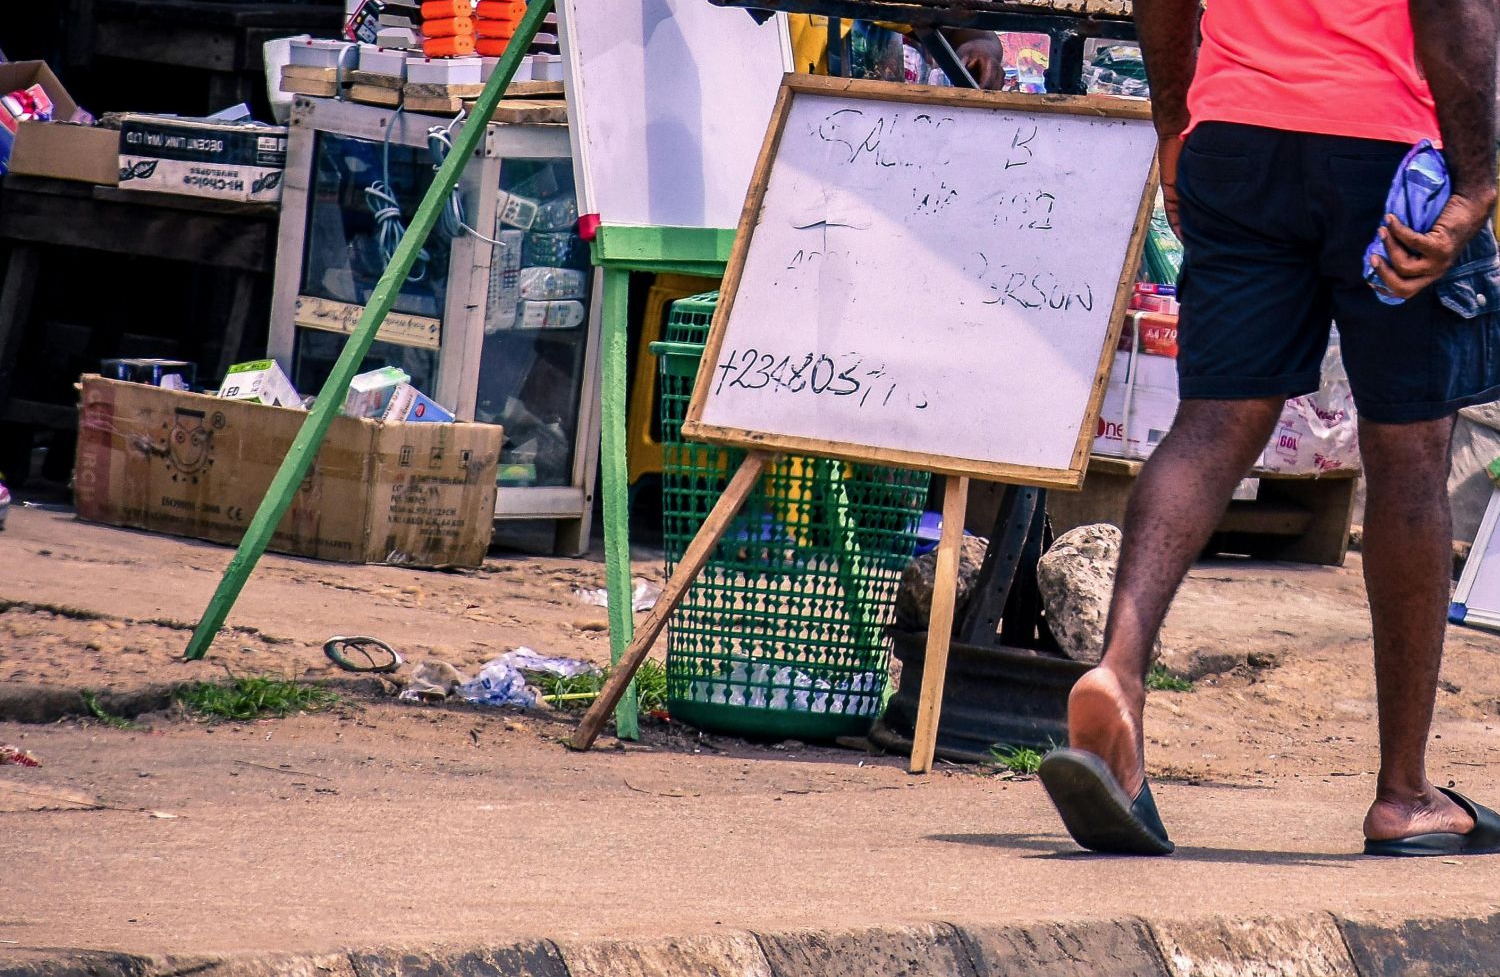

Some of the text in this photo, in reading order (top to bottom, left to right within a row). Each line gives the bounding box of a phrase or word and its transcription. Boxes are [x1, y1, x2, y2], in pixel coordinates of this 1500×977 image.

[183, 174, 244, 192] Hi-Choice
[1147, 328, 1178, 340] A4 70
[221, 386, 239, 398] LED
